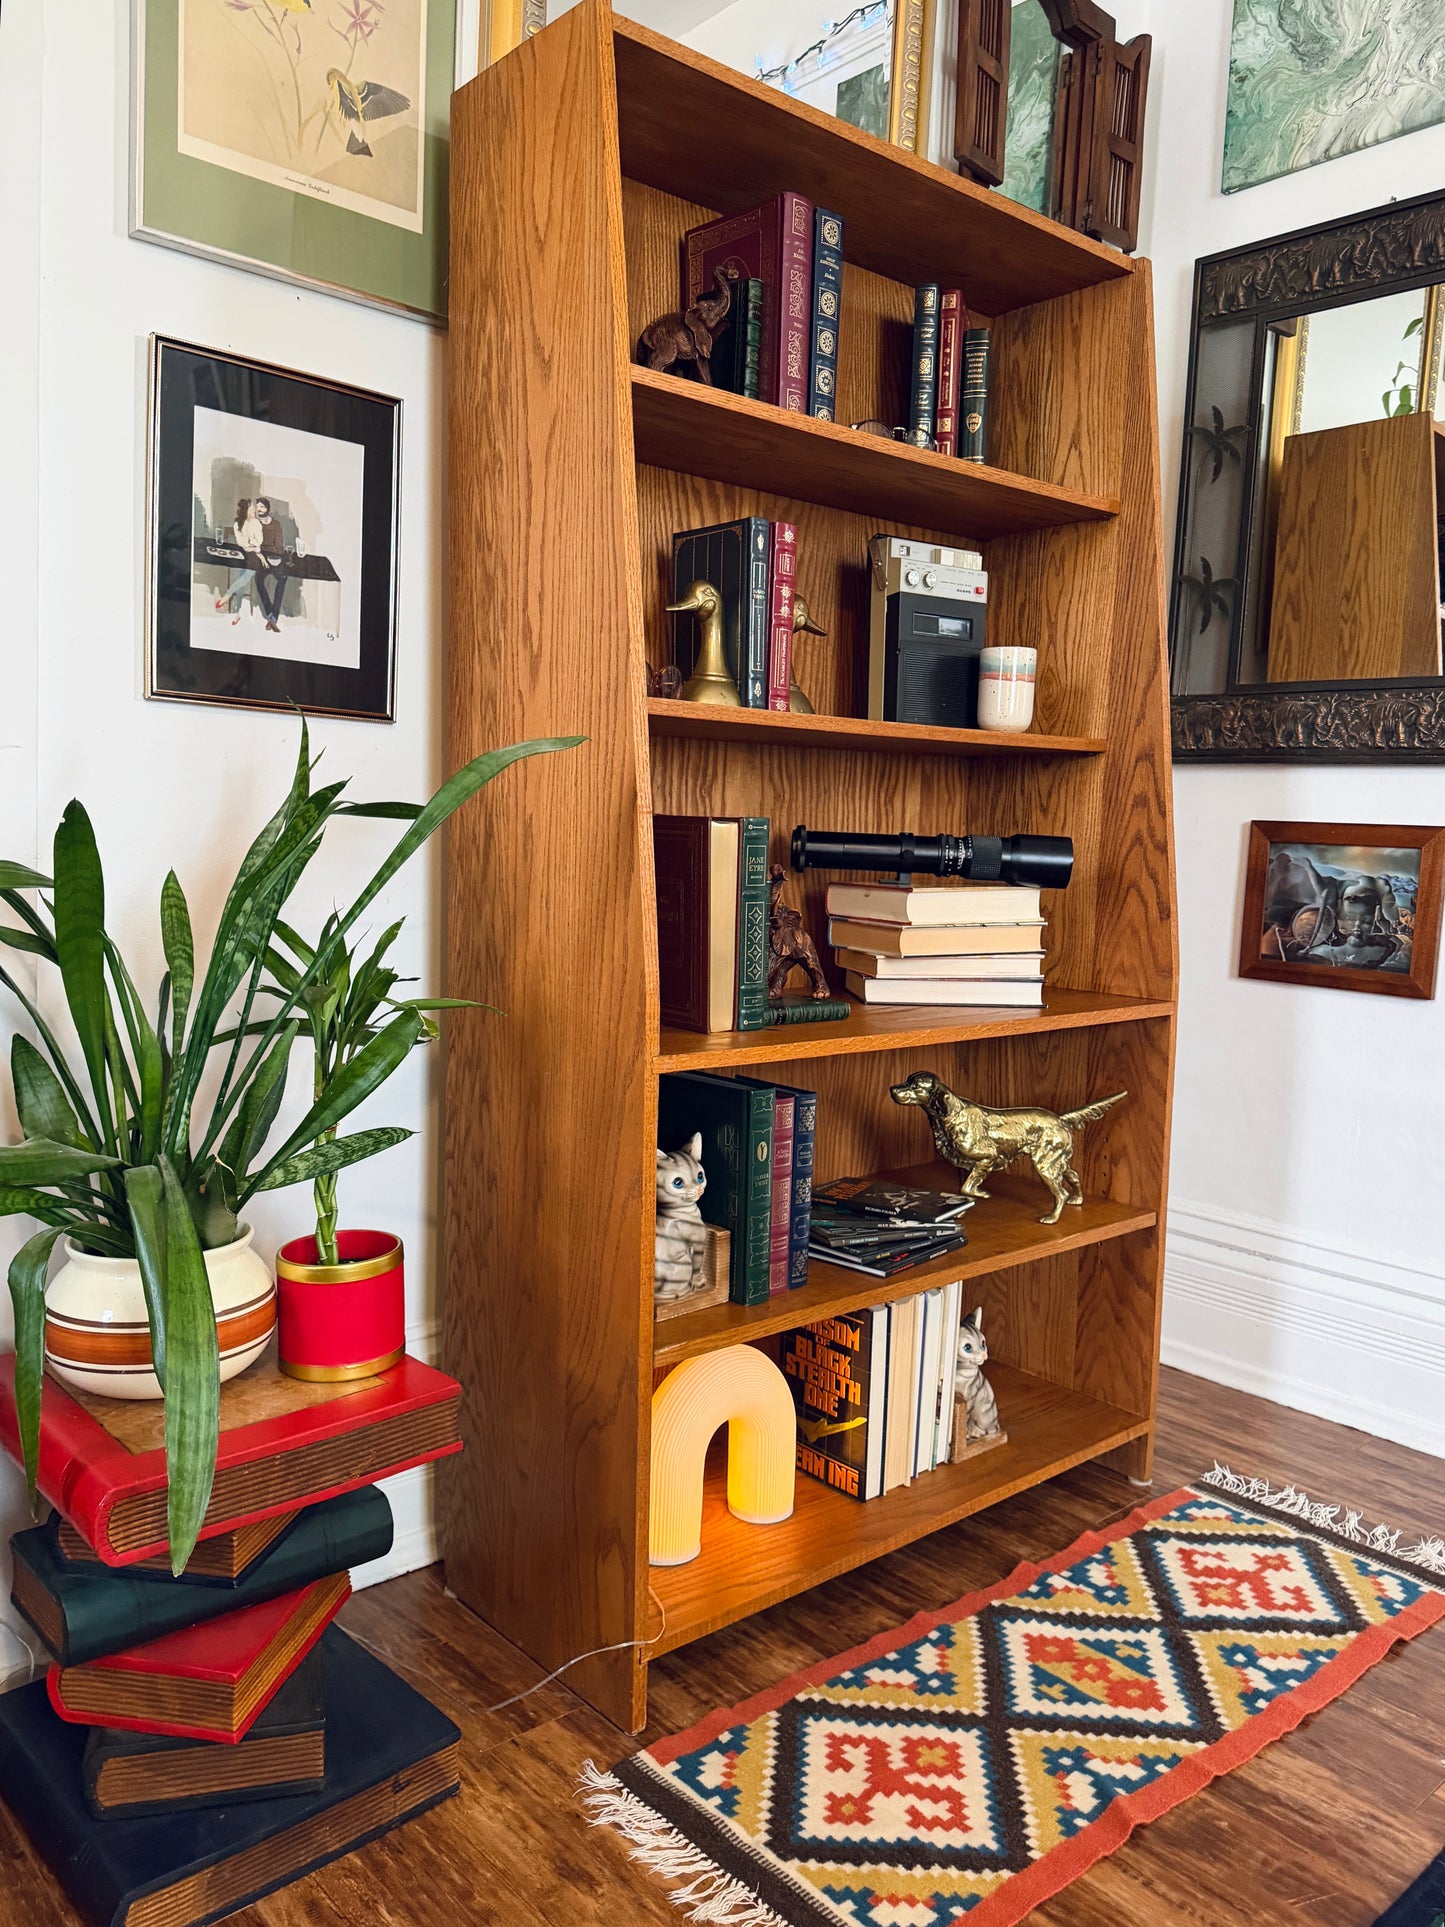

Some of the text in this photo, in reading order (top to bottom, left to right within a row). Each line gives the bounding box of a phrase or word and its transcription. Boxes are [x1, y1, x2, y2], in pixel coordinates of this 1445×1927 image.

[801, 1317, 860, 1352] NSOM
[815, 1335, 831, 1346] OF
[796, 1335, 852, 1380] BLACK
[785, 1352, 861, 1406] STEALTH
[805, 1382, 838, 1418] ONE
[796, 1445, 859, 1498] EAN ING
